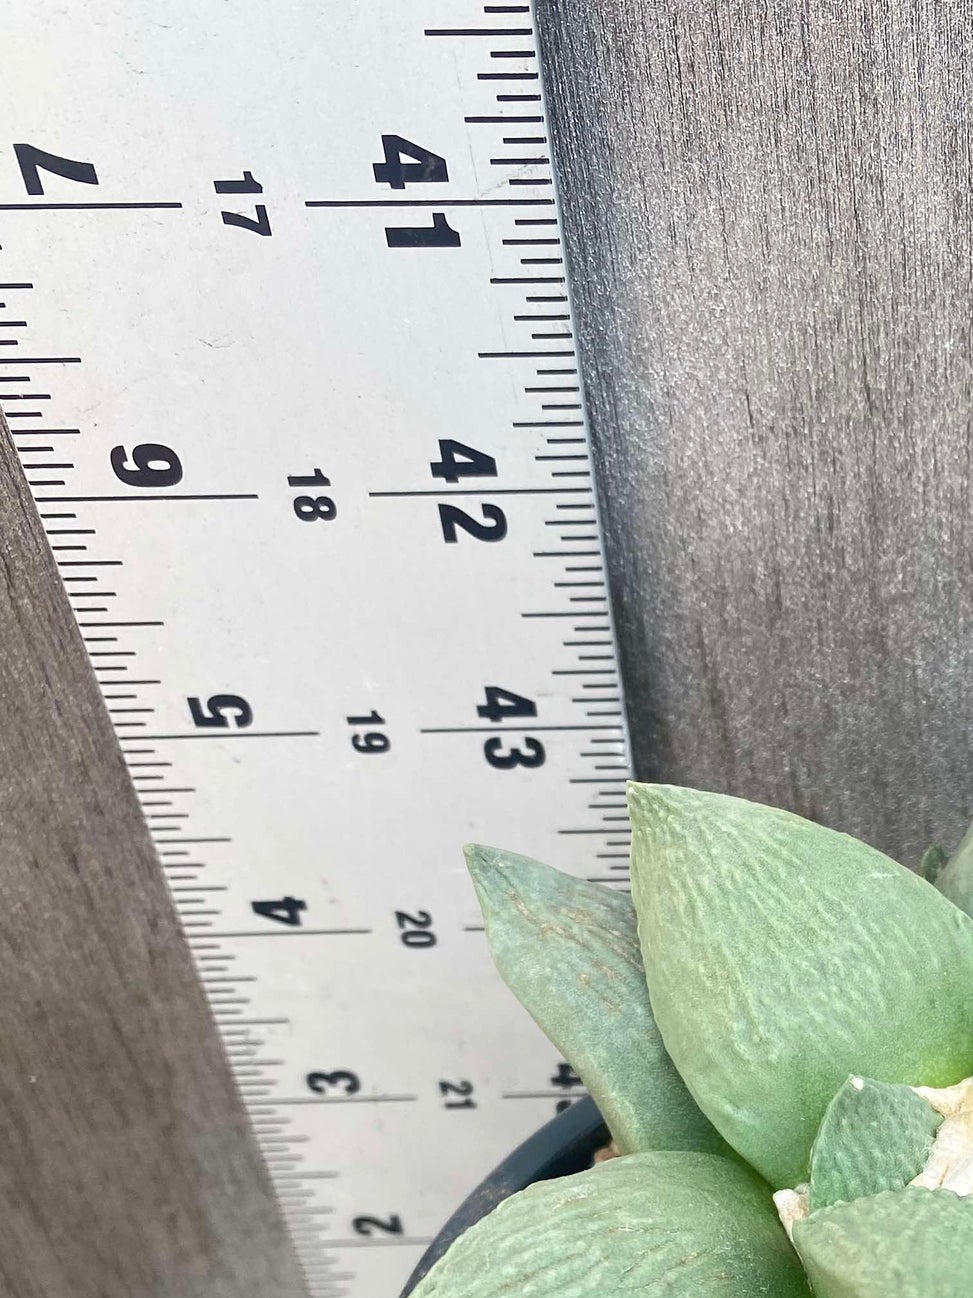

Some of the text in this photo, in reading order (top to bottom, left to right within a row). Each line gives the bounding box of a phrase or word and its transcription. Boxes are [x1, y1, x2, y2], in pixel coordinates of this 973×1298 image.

[12, 143, 99, 196] 7
[372, 134, 462, 248] 41
[213, 170, 273, 237] 17
[109, 443, 183, 488] 6
[287, 468, 337, 522] 18
[429, 439, 508, 543] 42
[187, 694, 253, 728] 5
[346, 710, 390, 754] 19
[476, 686, 546, 770] 43
[251, 896, 307, 926] 4
[395, 911, 437, 948] 20
[305, 1070, 361, 1095] 3
[438, 1080, 477, 1110] 21
[352, 1214, 404, 1237] 2
